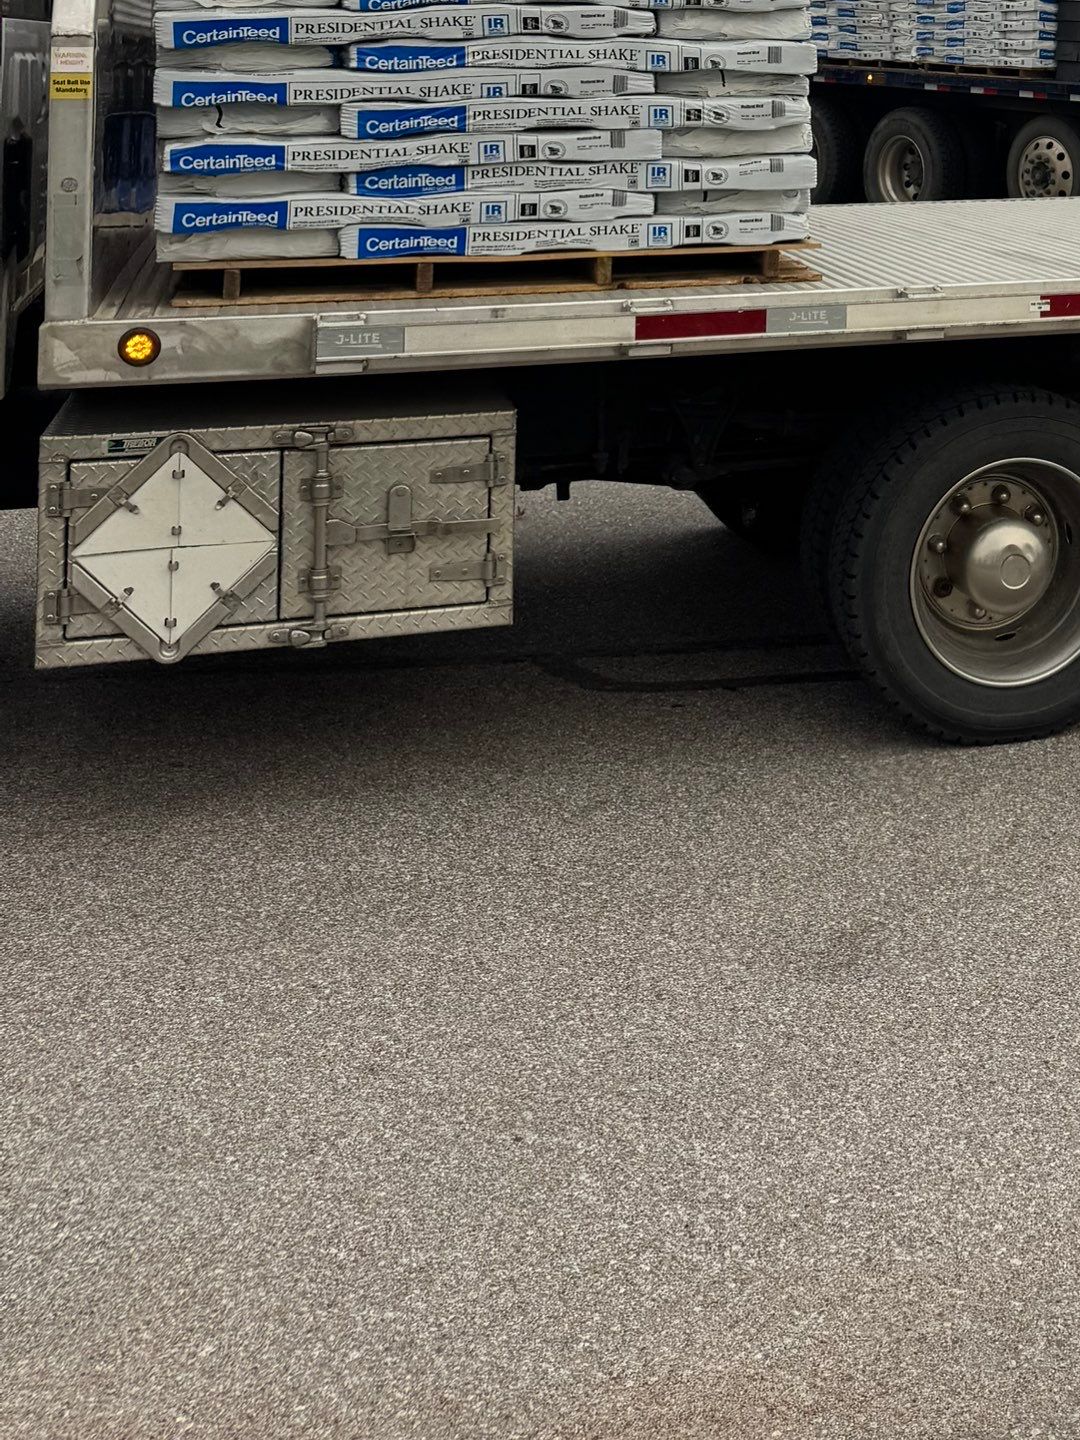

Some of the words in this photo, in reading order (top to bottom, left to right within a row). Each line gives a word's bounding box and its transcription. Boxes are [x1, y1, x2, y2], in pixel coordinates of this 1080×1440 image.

[295, 19, 416, 34] PRESIDENTIAL
[420, 16, 474, 29] SHAKE
[182, 26, 280, 44] CertainTeed
[365, 54, 457, 70] CertainTeed
[472, 48, 585, 60] PRESIDENTIAL
[588, 48, 637, 61] SHAKE
[181, 90, 278, 106] CertainTeed
[293, 86, 415, 101] PRESIDENTIAL
[419, 83, 472, 98] SHAKE
[473, 107, 587, 120] PRESIDENTIAL
[590, 105, 640, 116] SHAKE
[366, 115, 458, 134] CertainTeed
[292, 147, 412, 161] PRESIDENTIAL
[416, 142, 471, 156] SHAKE
[179, 154, 275, 170] CertainTeed
[471, 165, 585, 179] PRESIDENTIAL
[588, 163, 639, 176] SHAKE
[365, 173, 456, 190] CertainTeed
[293, 205, 414, 218] PRESIDENTIAL
[418, 202, 472, 216] SHAKE
[181, 211, 279, 228] CertainTeed
[472, 227, 586, 243] PRESIDENTIAL
[589, 224, 639, 237] SHAKE
[366, 236, 458, 252] CertainTeed
[789, 310, 828, 321] J-LITE
[336, 332, 381, 345] J-LITE
